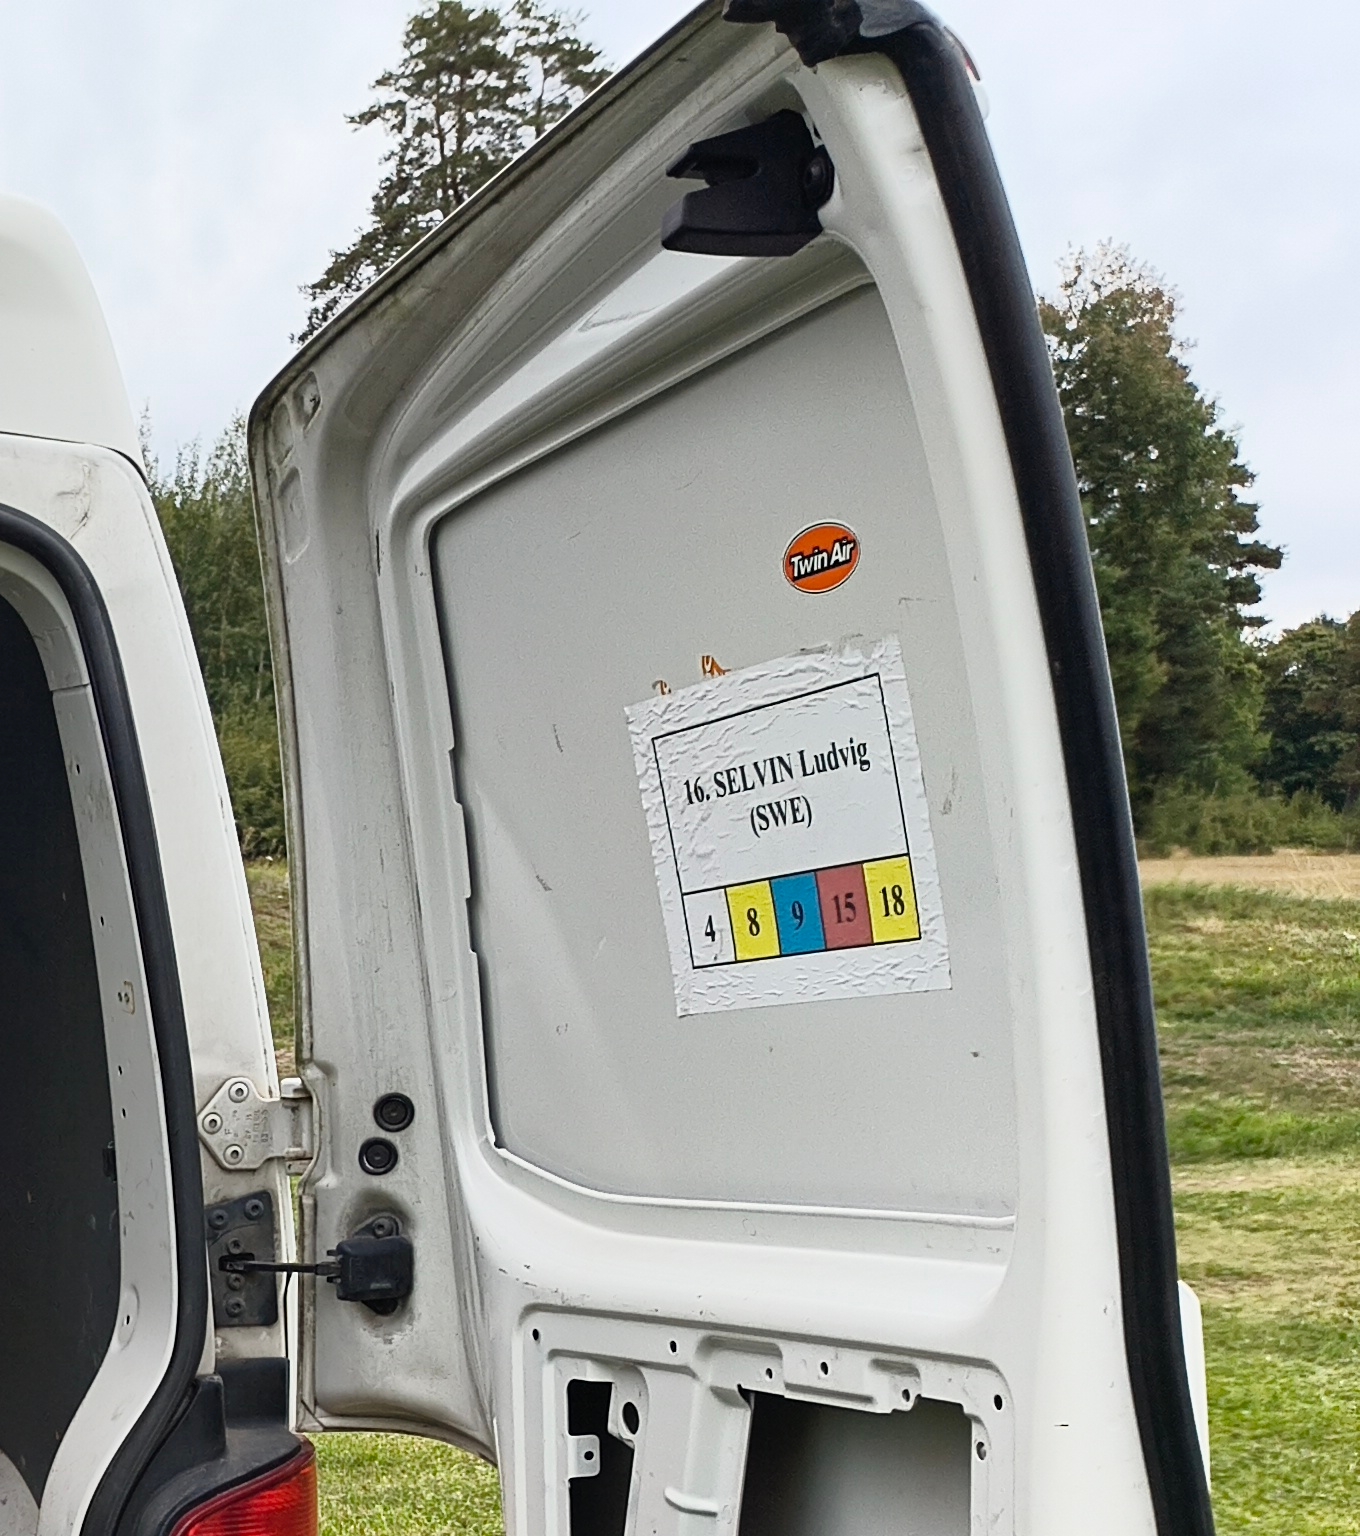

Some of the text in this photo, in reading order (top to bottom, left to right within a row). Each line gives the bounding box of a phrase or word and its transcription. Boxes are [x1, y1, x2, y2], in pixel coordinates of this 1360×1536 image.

[790, 538, 854, 577] Twin Air
[683, 737, 871, 806] 16. SELVIN Ludvig
[750, 795, 812, 838] (SWE)
[704, 884, 906, 942] 4 8 9 15 18
